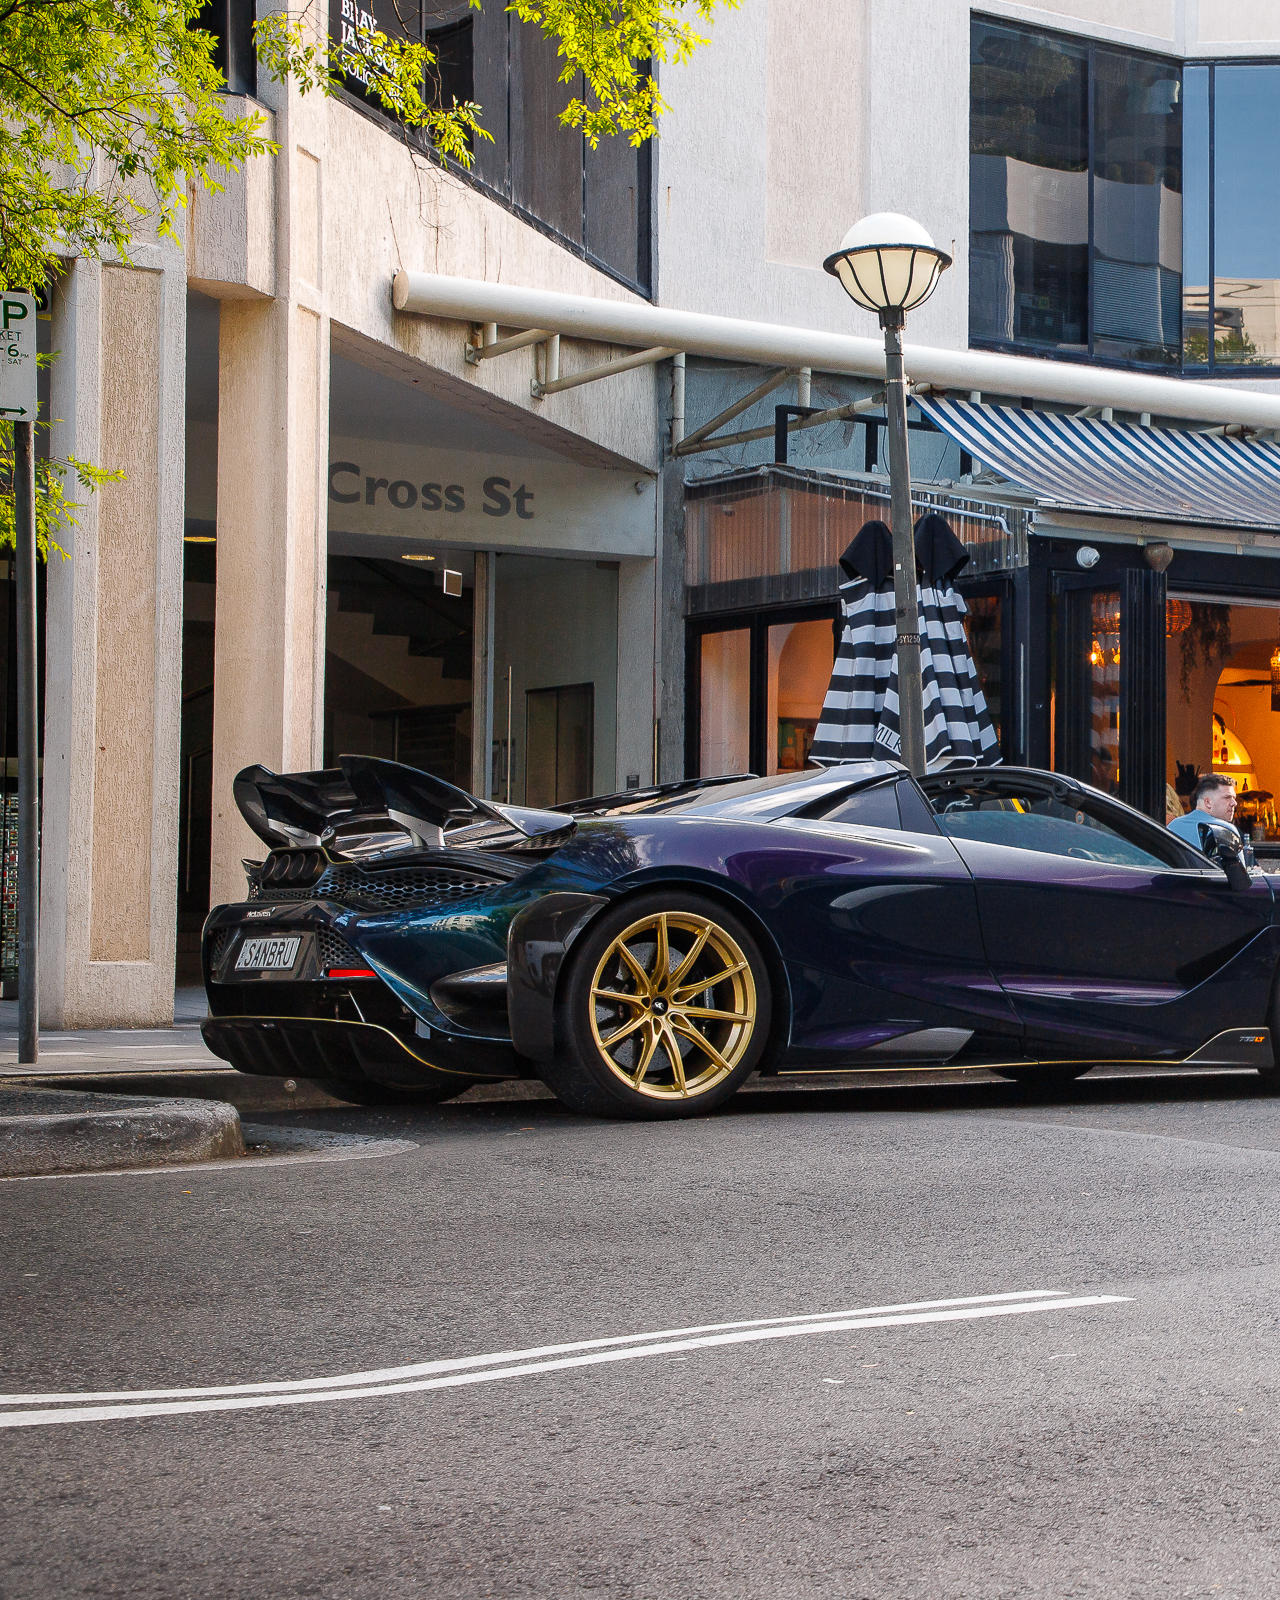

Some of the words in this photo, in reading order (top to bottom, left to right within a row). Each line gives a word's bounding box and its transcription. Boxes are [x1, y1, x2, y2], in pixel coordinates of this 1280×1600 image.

[328, 461, 465, 513] Cross
[482, 476, 534, 519] St
[244, 941, 296, 967] SANBRU
